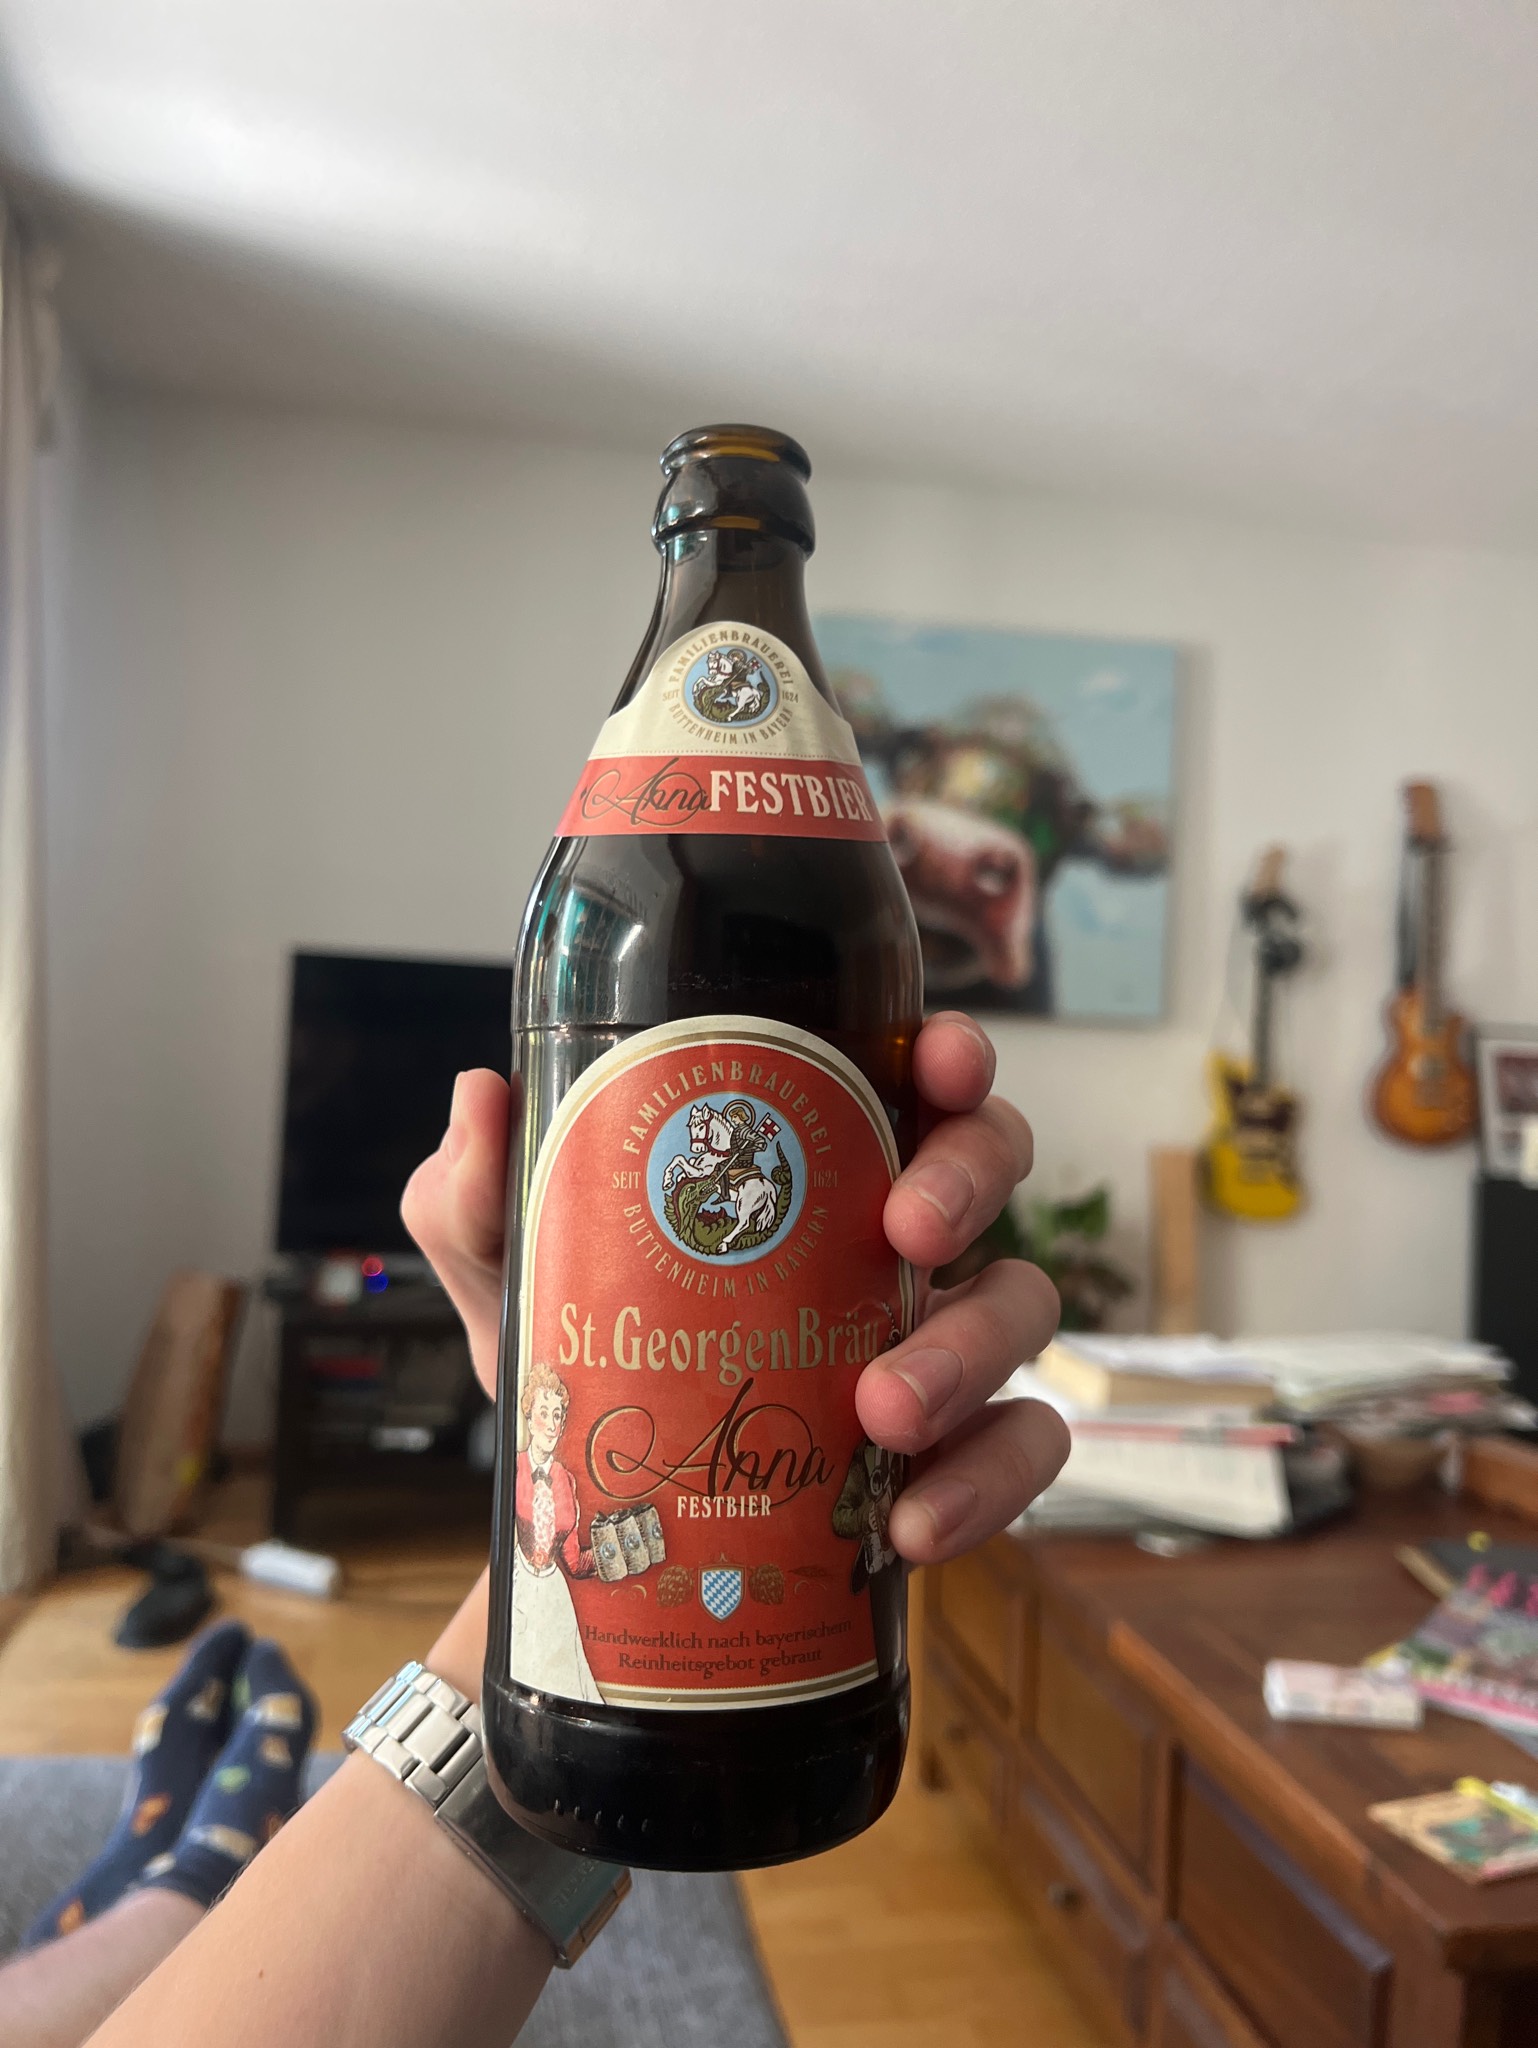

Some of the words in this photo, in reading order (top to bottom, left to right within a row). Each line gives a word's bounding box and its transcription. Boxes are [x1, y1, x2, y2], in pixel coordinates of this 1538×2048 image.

[669, 630, 794, 684] FAMILIENBRAUEREI
[662, 689, 680, 702] SEIT
[782, 690, 799, 703] 1624
[669, 703, 738, 744] BUTTENHEIM
[743, 731, 758, 743] IN
[759, 707, 793, 740] BAYERN
[580, 757, 711, 827] Anna
[709, 770, 874, 822] FESTBIER
[623, 1060, 832, 1156] FAMILIENBRAUEREI
[612, 1171, 641, 1189] SEIT
[623, 1203, 737, 1298] BUTTENHEIM
[746, 1274, 769, 1295] IN
[774, 1205, 828, 1281] BAYERN
[559, 1303, 607, 1369] St.
[585, 1377, 835, 1509] Anna
[677, 1495, 772, 1519] FESTBIER
[584, 1625, 702, 1649] Handwerklich
[708, 1632, 750, 1649] nach
[755, 1618, 852, 1649] bayerischem
[618, 1652, 755, 1679] Reinheitsgebot
[760, 1648, 822, 1675] gebraut
